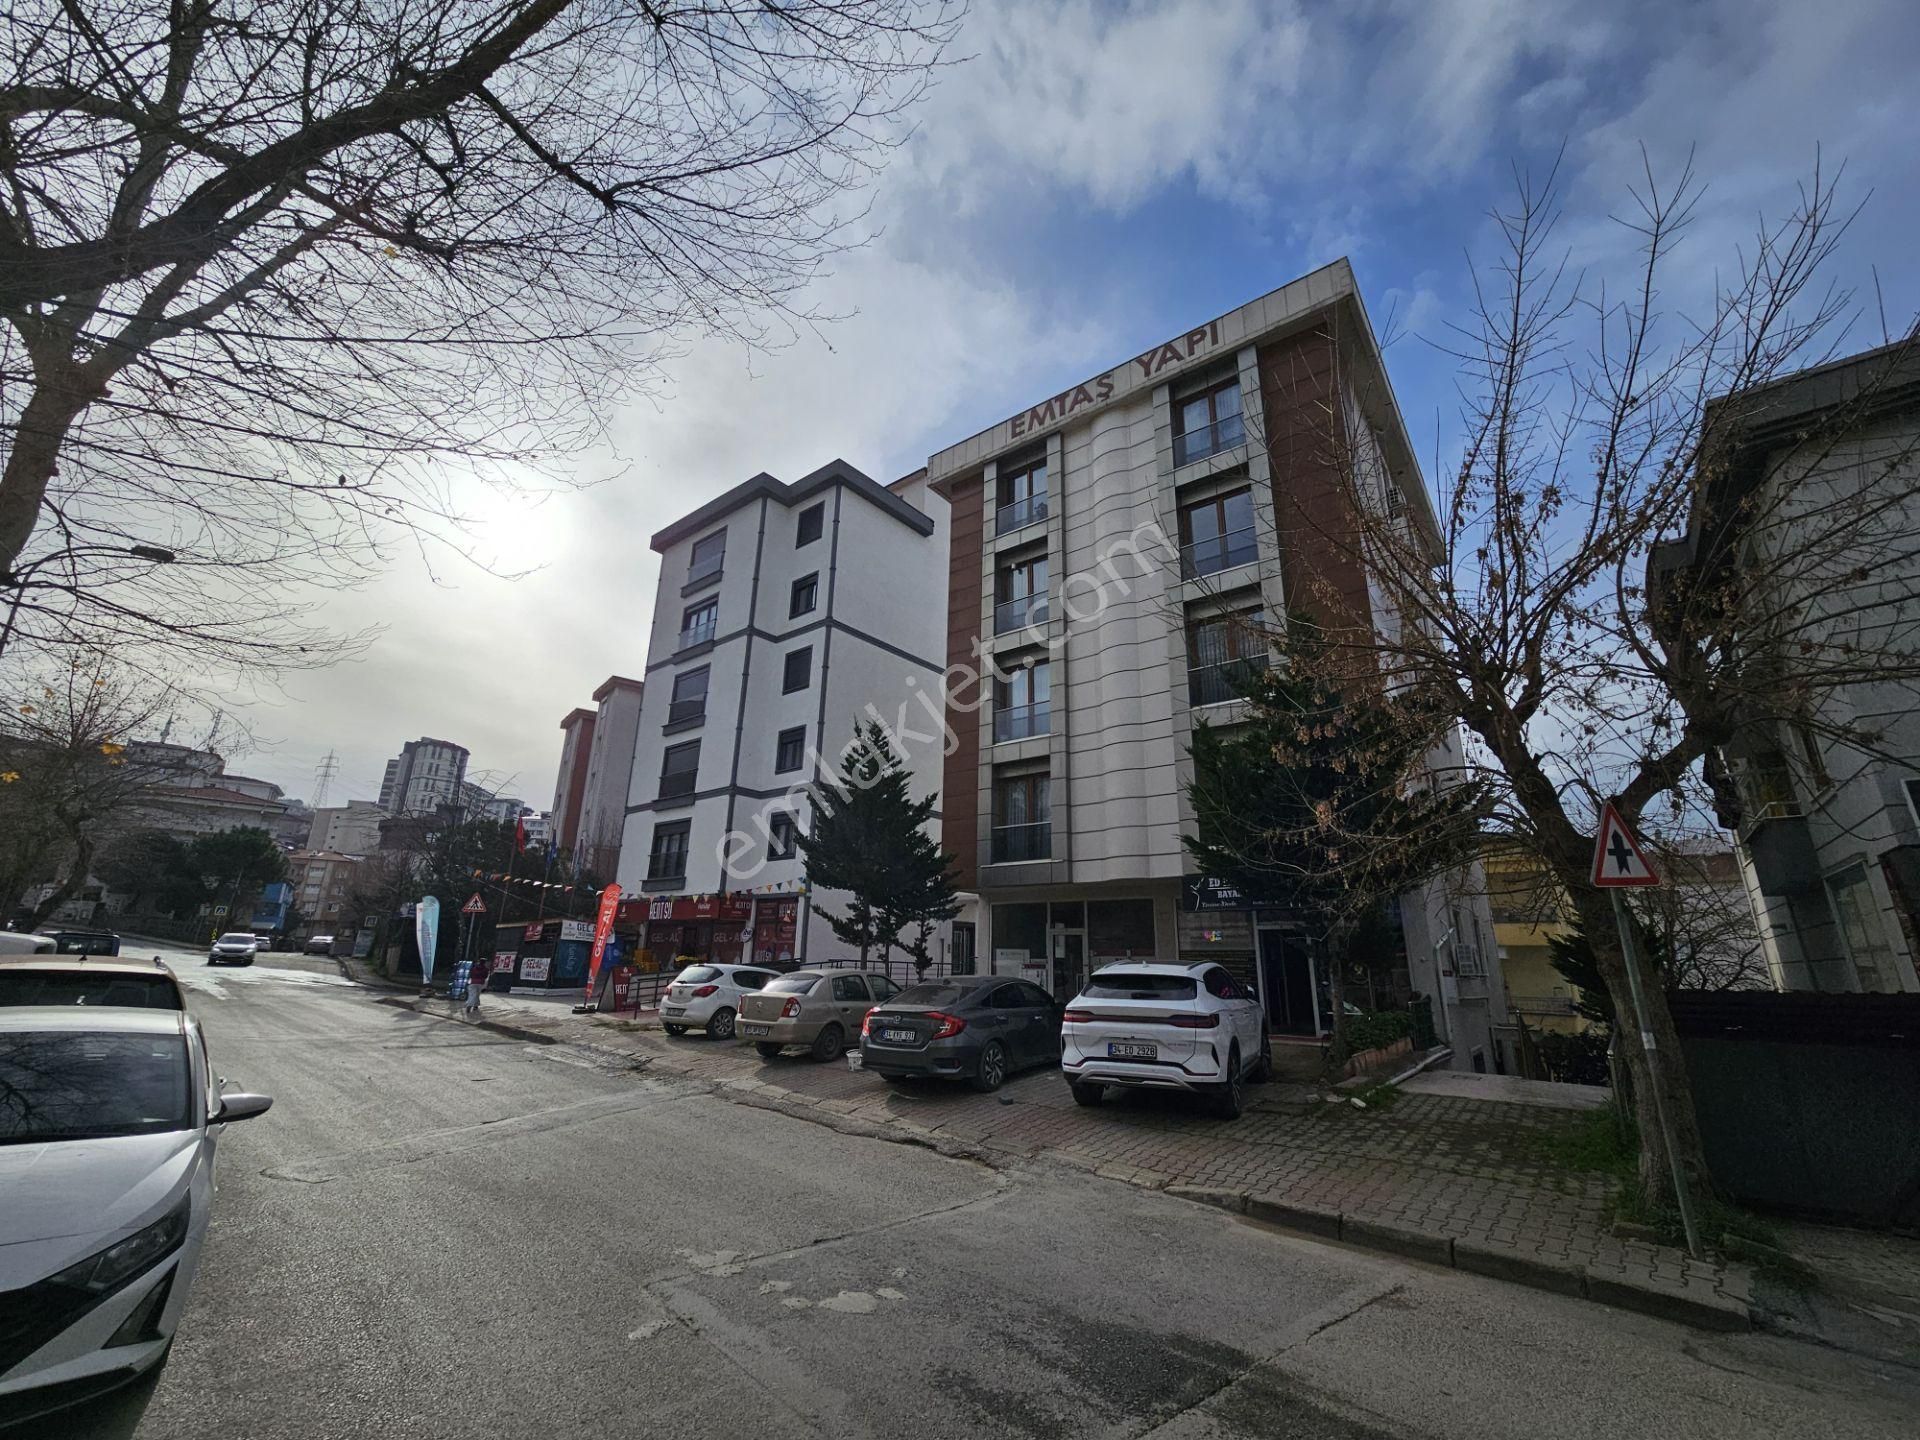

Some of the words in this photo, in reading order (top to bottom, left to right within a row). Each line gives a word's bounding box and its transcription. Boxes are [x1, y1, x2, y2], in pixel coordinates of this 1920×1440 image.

[1010, 373, 1115, 439] EMTAŞ
[1135, 322, 1220, 378] YAPI
[1217, 890, 1240, 898] BAYA
[1112, 1045, 1121, 1053] 34
